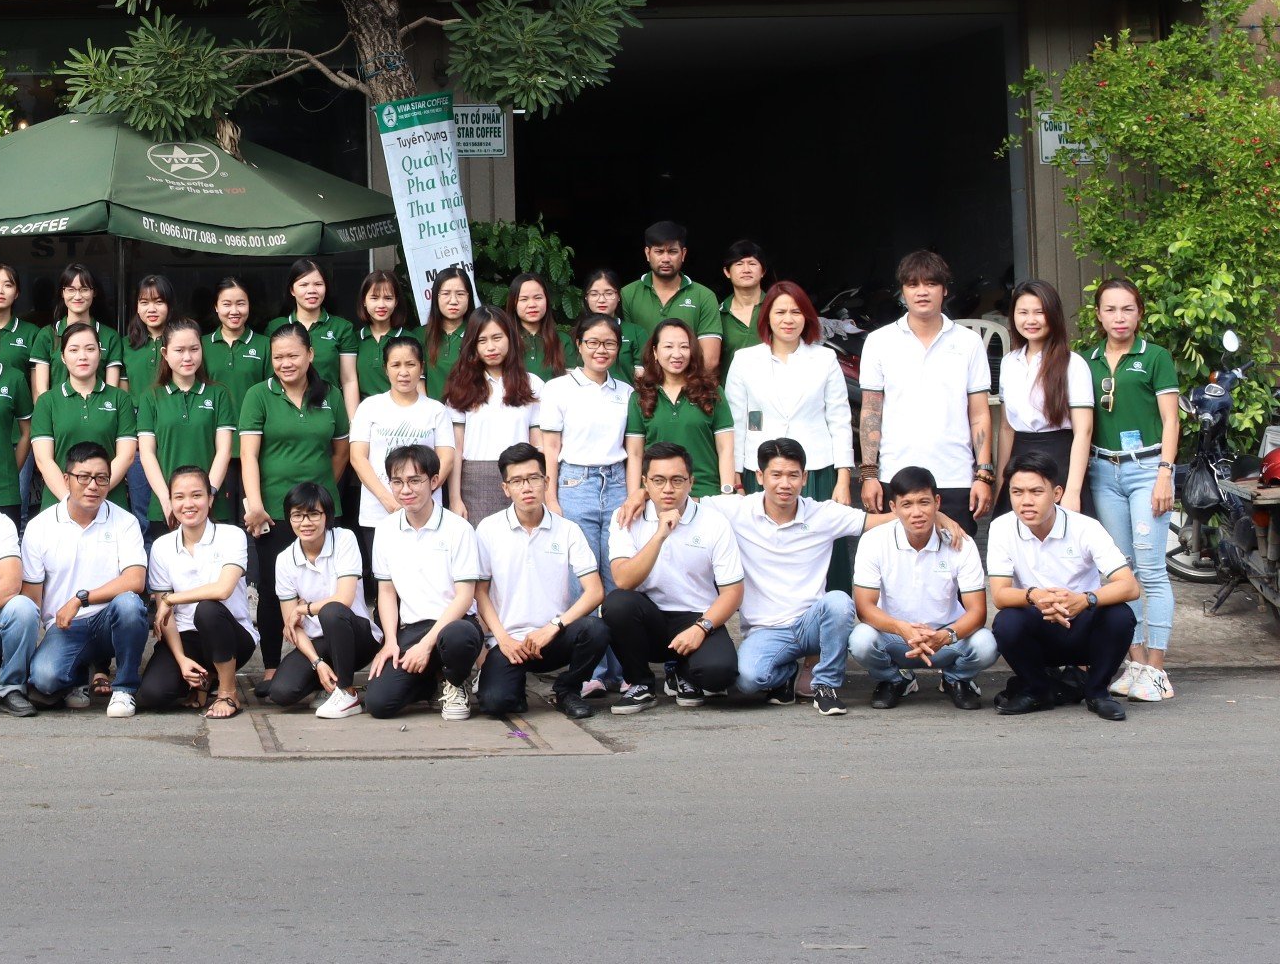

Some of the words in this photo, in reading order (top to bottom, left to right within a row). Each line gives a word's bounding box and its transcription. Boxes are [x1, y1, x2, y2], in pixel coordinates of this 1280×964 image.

[411, 100, 426, 111] STAR
[426, 96, 449, 108] COFFEE
[461, 112, 471, 125] TY
[396, 131, 425, 149] Tuyển
[424, 130, 448, 144] Dụng
[457, 126, 475, 139] STAR
[476, 126, 502, 139] COFFEE
[440, 146, 453, 169] lý
[186, 186, 201, 194] the
[406, 176, 437, 196] Pha
[406, 199, 436, 219] Thu
[10, 217, 70, 235] COFFEE
[142, 216, 159, 233] ĐT:
[160, 221, 218, 245] 0966.077.088
[224, 234, 288, 248] 0966.001.002
[349, 225, 367, 242] STAR
[367, 219, 397, 238] COFFEE
[434, 245, 459, 260] Liên
